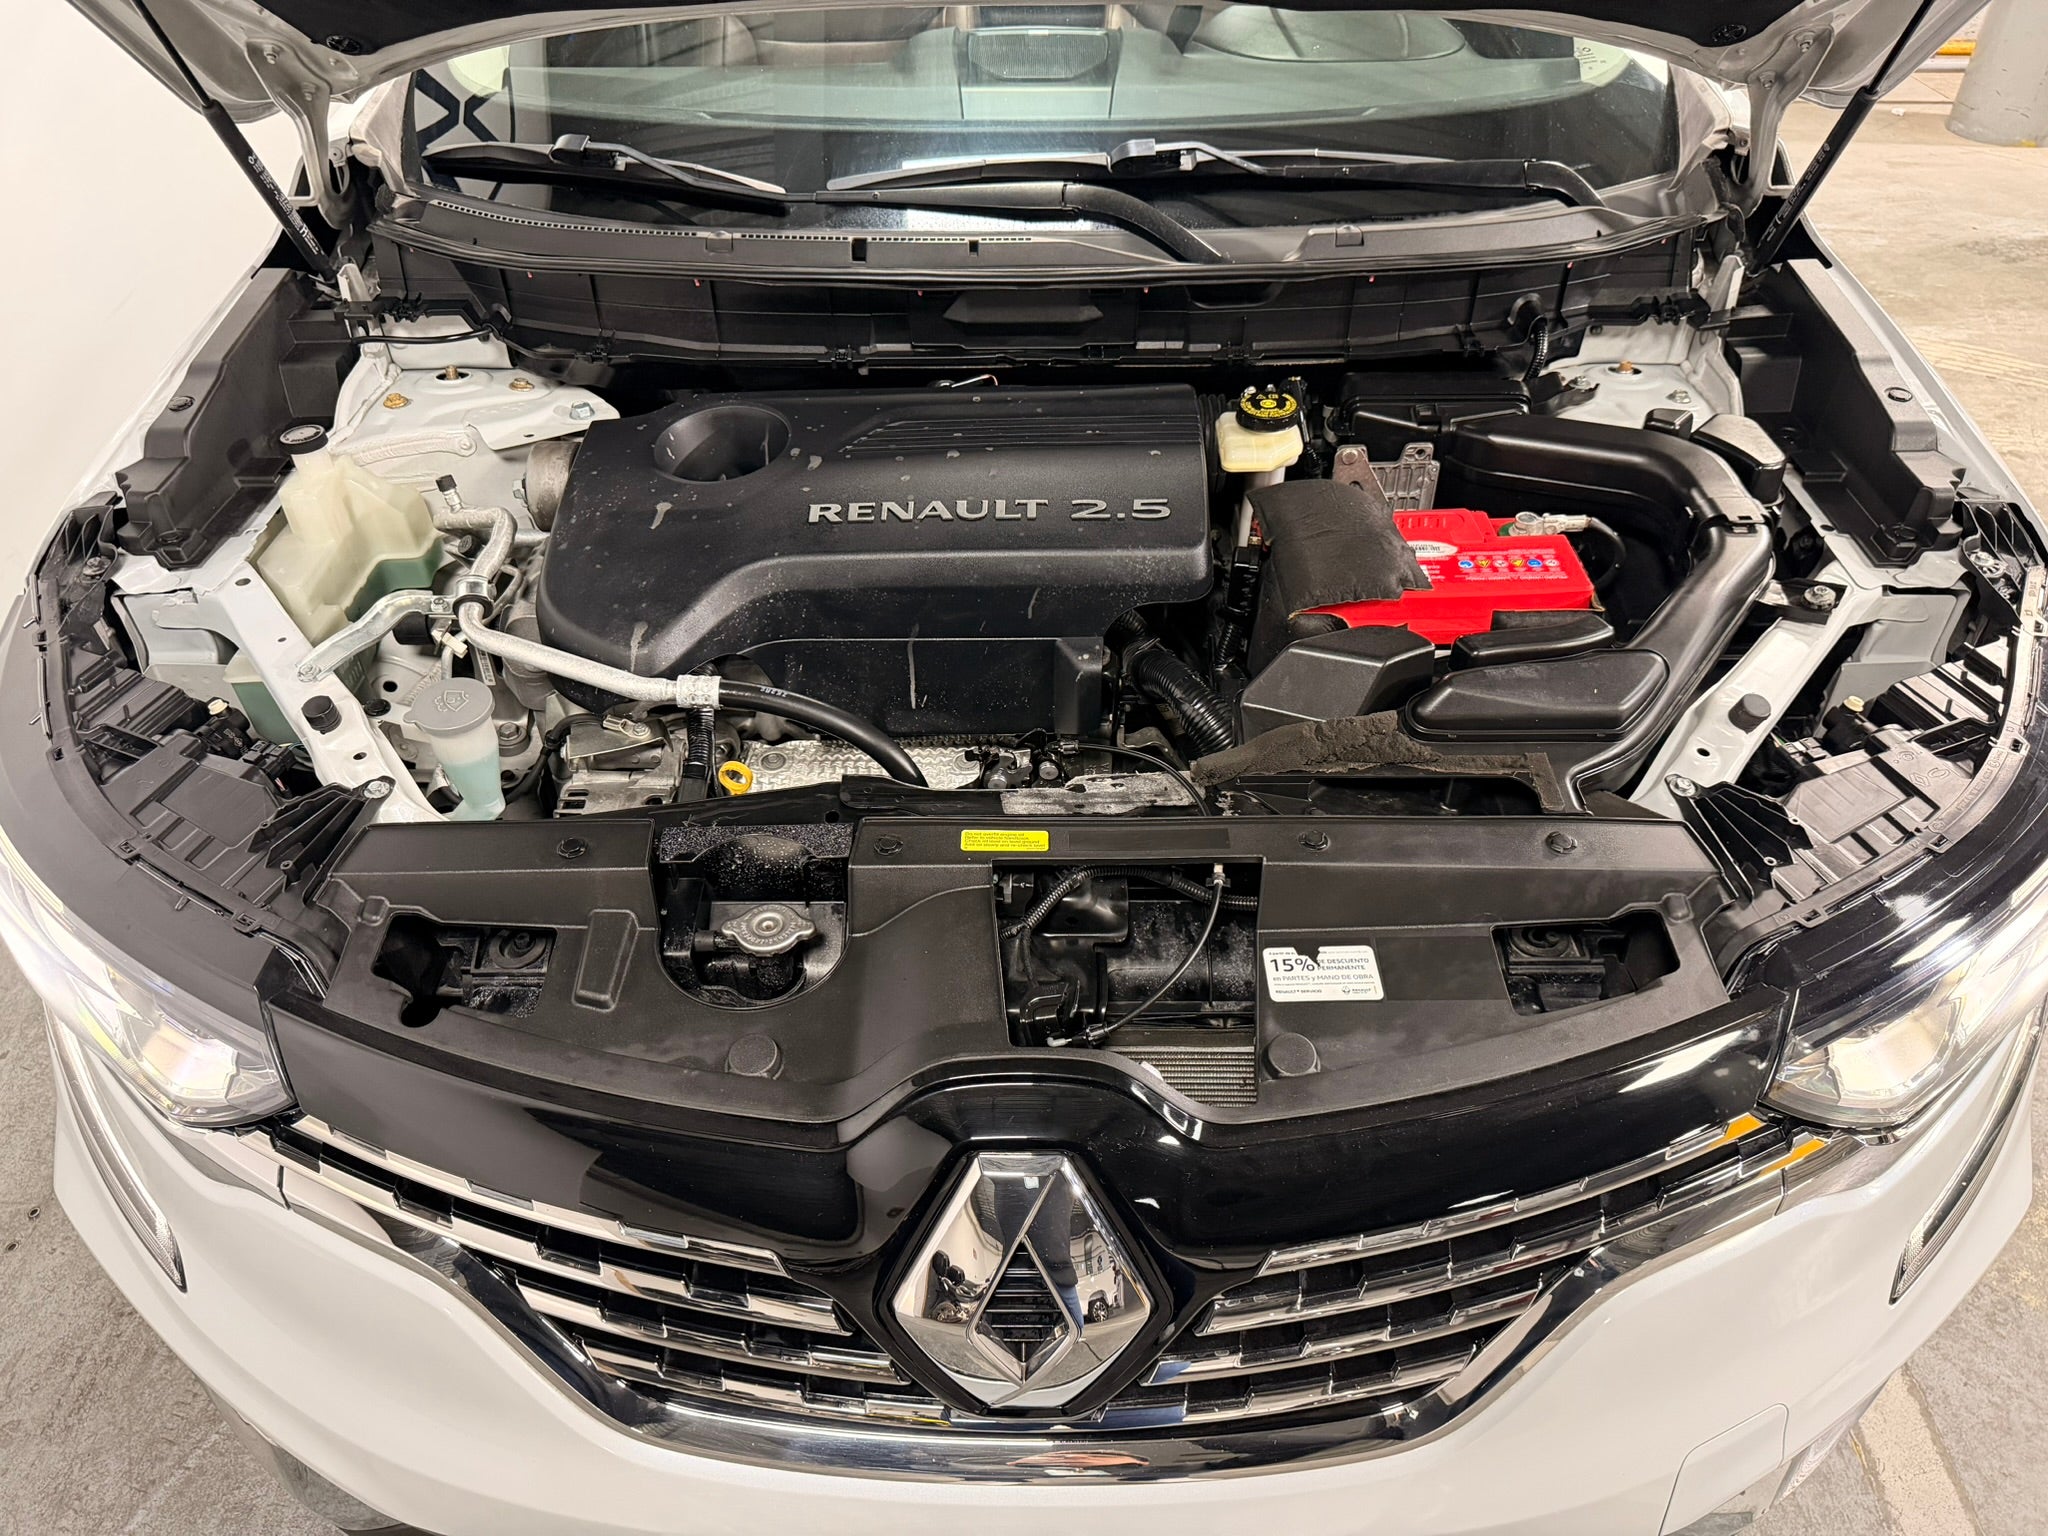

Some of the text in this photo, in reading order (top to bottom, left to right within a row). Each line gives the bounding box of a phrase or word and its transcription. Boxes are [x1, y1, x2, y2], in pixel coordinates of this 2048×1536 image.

[808, 498, 1172, 523] RENAULT 2.5
[1270, 957, 1315, 972] 15%
